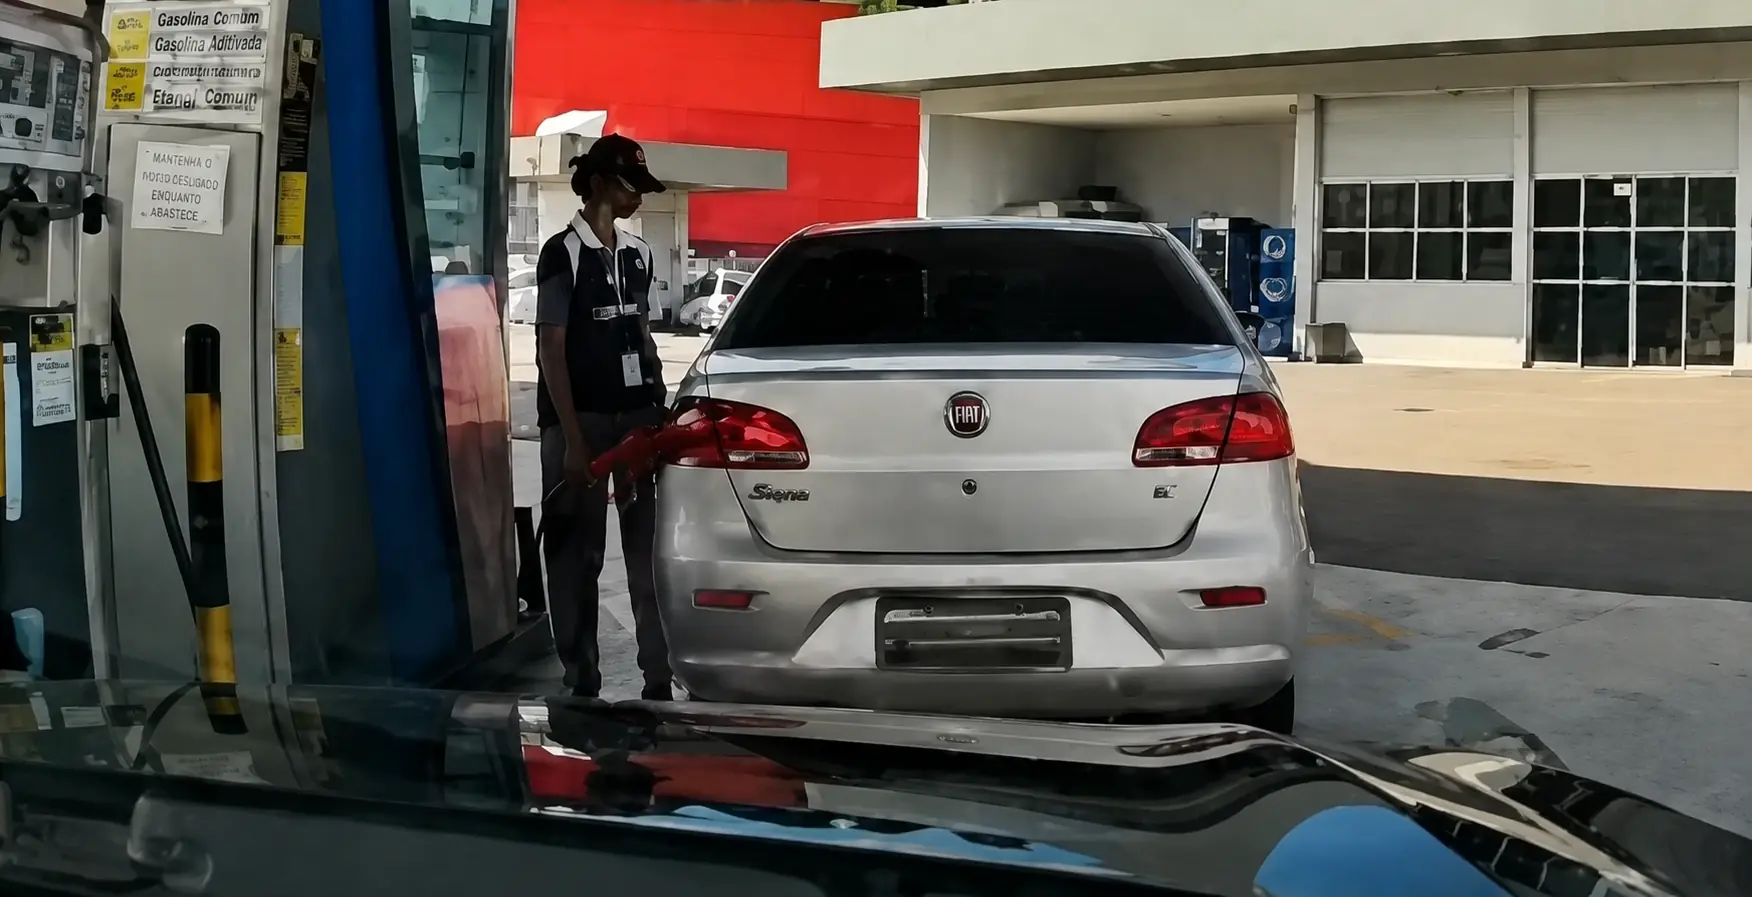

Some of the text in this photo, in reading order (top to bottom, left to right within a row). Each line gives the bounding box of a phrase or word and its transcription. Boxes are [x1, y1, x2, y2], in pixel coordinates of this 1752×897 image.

[158, 11, 209, 27] Gasolina
[213, 11, 259, 25] Comum
[155, 35, 205, 52] Gasolina
[208, 34, 262, 51] Aditivada
[152, 152, 212, 168] MANTENHA O
[151, 189, 201, 204] ENQUANTO
[150, 207, 199, 222] ABASTECE
[955, 405, 980, 424] FIAT
